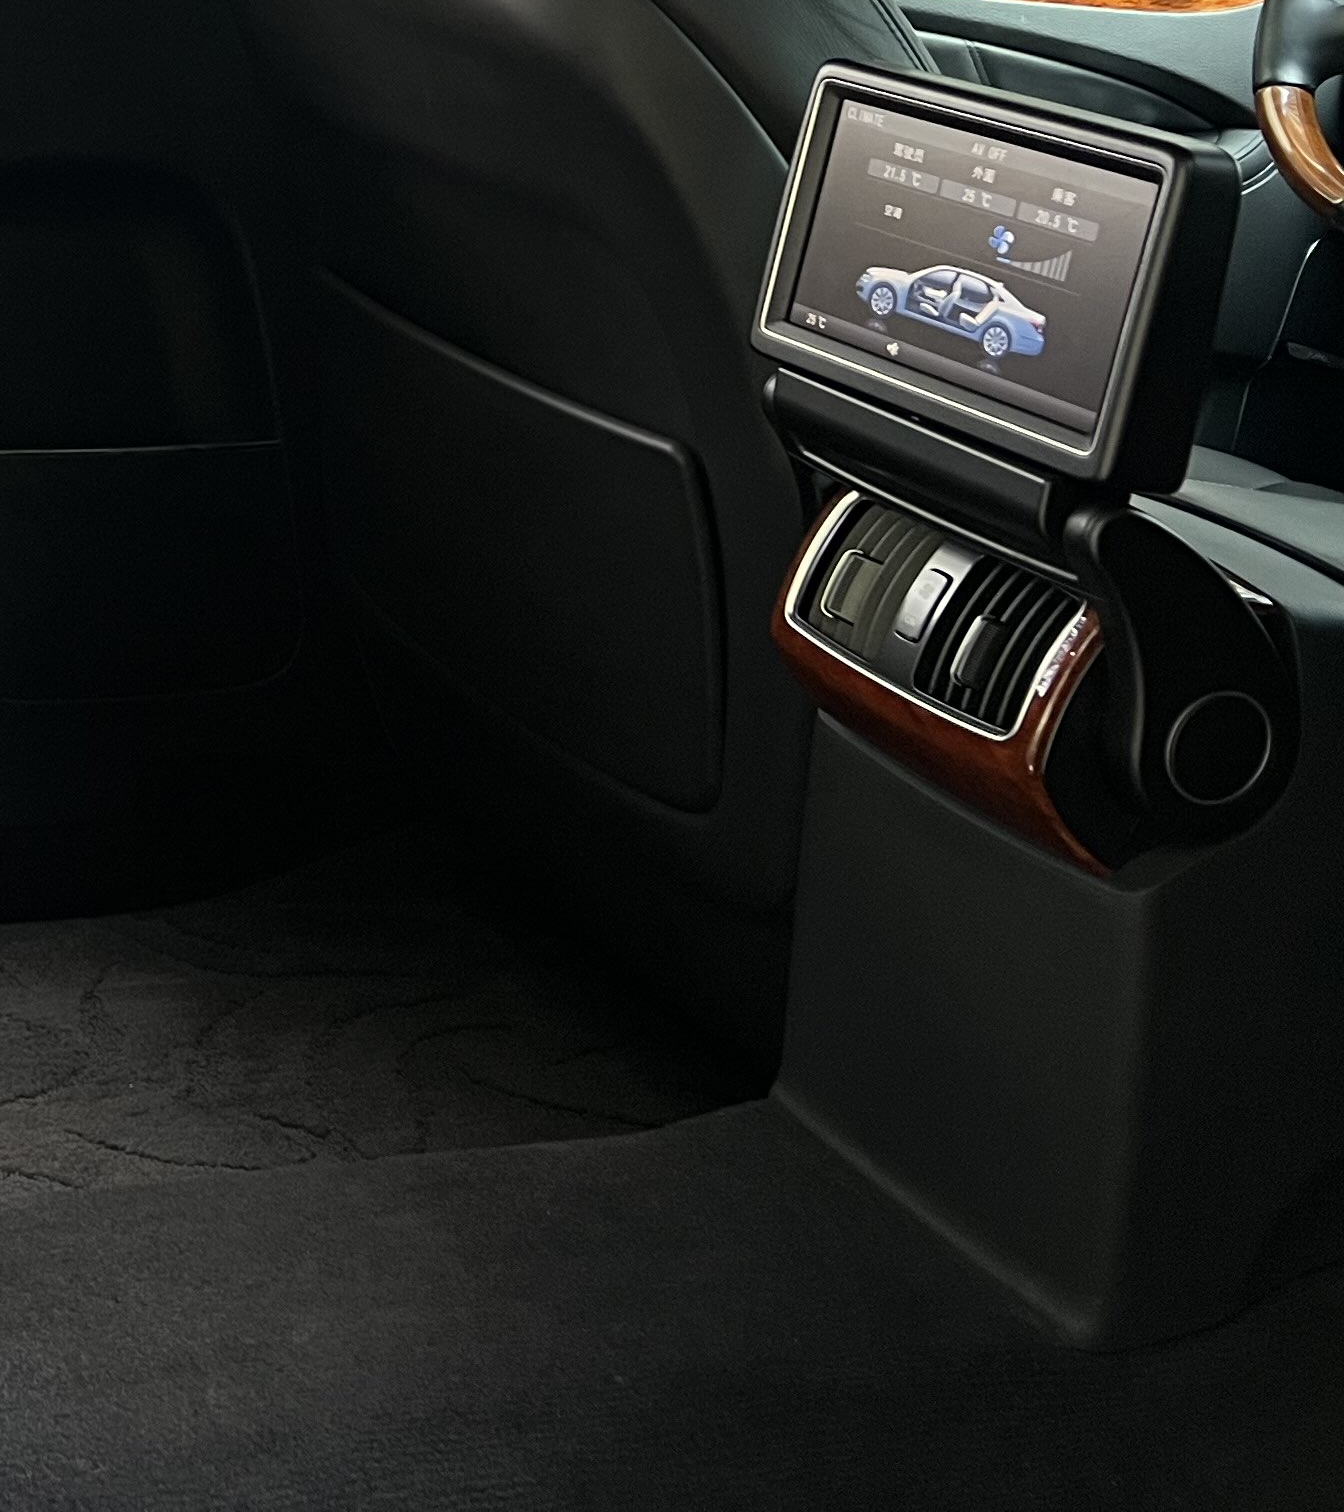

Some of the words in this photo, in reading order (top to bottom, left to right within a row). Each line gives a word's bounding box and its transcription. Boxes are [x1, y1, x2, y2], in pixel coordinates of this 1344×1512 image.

[988, 146, 1009, 162] OFF
[883, 164, 907, 183] 21.5
[962, 187, 977, 204] 25
